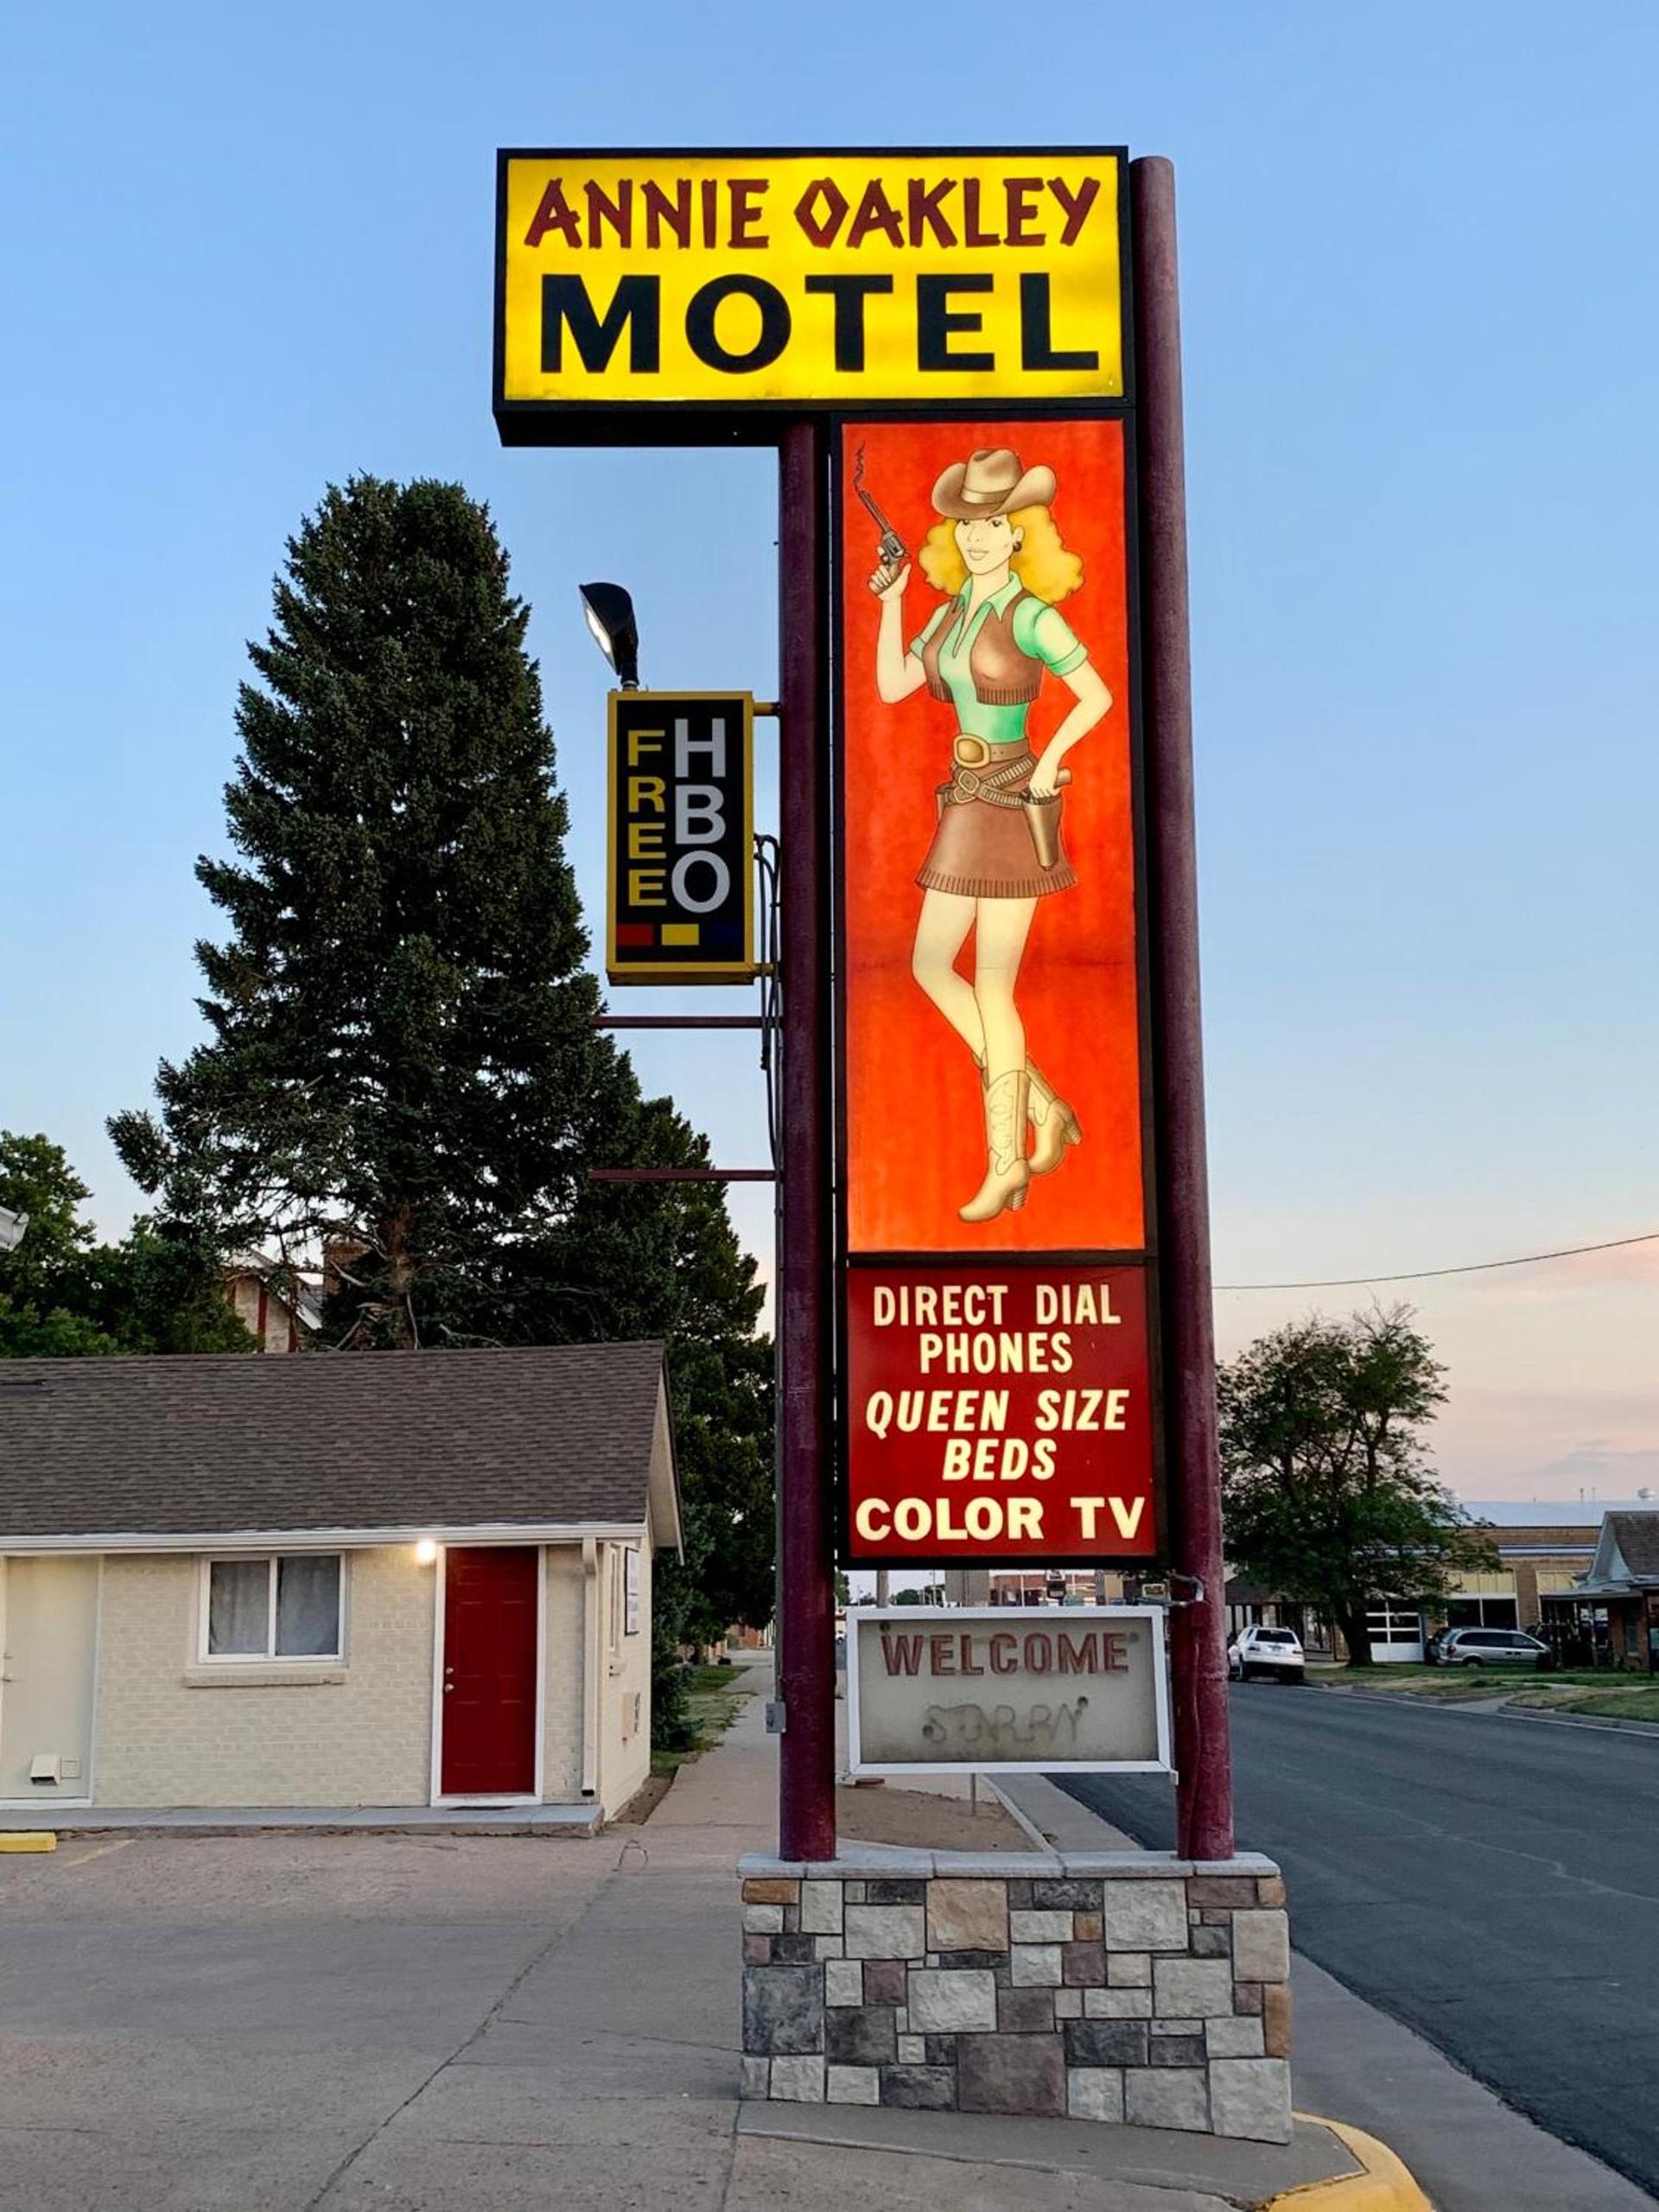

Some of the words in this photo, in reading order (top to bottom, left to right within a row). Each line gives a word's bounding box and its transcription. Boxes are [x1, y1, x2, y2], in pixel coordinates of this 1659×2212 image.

[524, 177, 770, 250] ANNIE
[793, 176, 1101, 249] OAKLEY
[540, 272, 1100, 374] MOTEL
[627, 730, 667, 907] FREE
[671, 718, 730, 913] HBO
[874, 1285, 1008, 1326] DIRECT
[1036, 1284, 1122, 1325] DIAL
[919, 1332, 1073, 1374] PHONES
[866, 1389, 1009, 1440] QUEEN
[1034, 1389, 1130, 1432] SIZE
[942, 1438, 1058, 1481] BEDS
[855, 1497, 1045, 1541] COLOR
[1070, 1497, 1145, 1540] TV
[880, 1632, 1129, 1676] WELCOME
